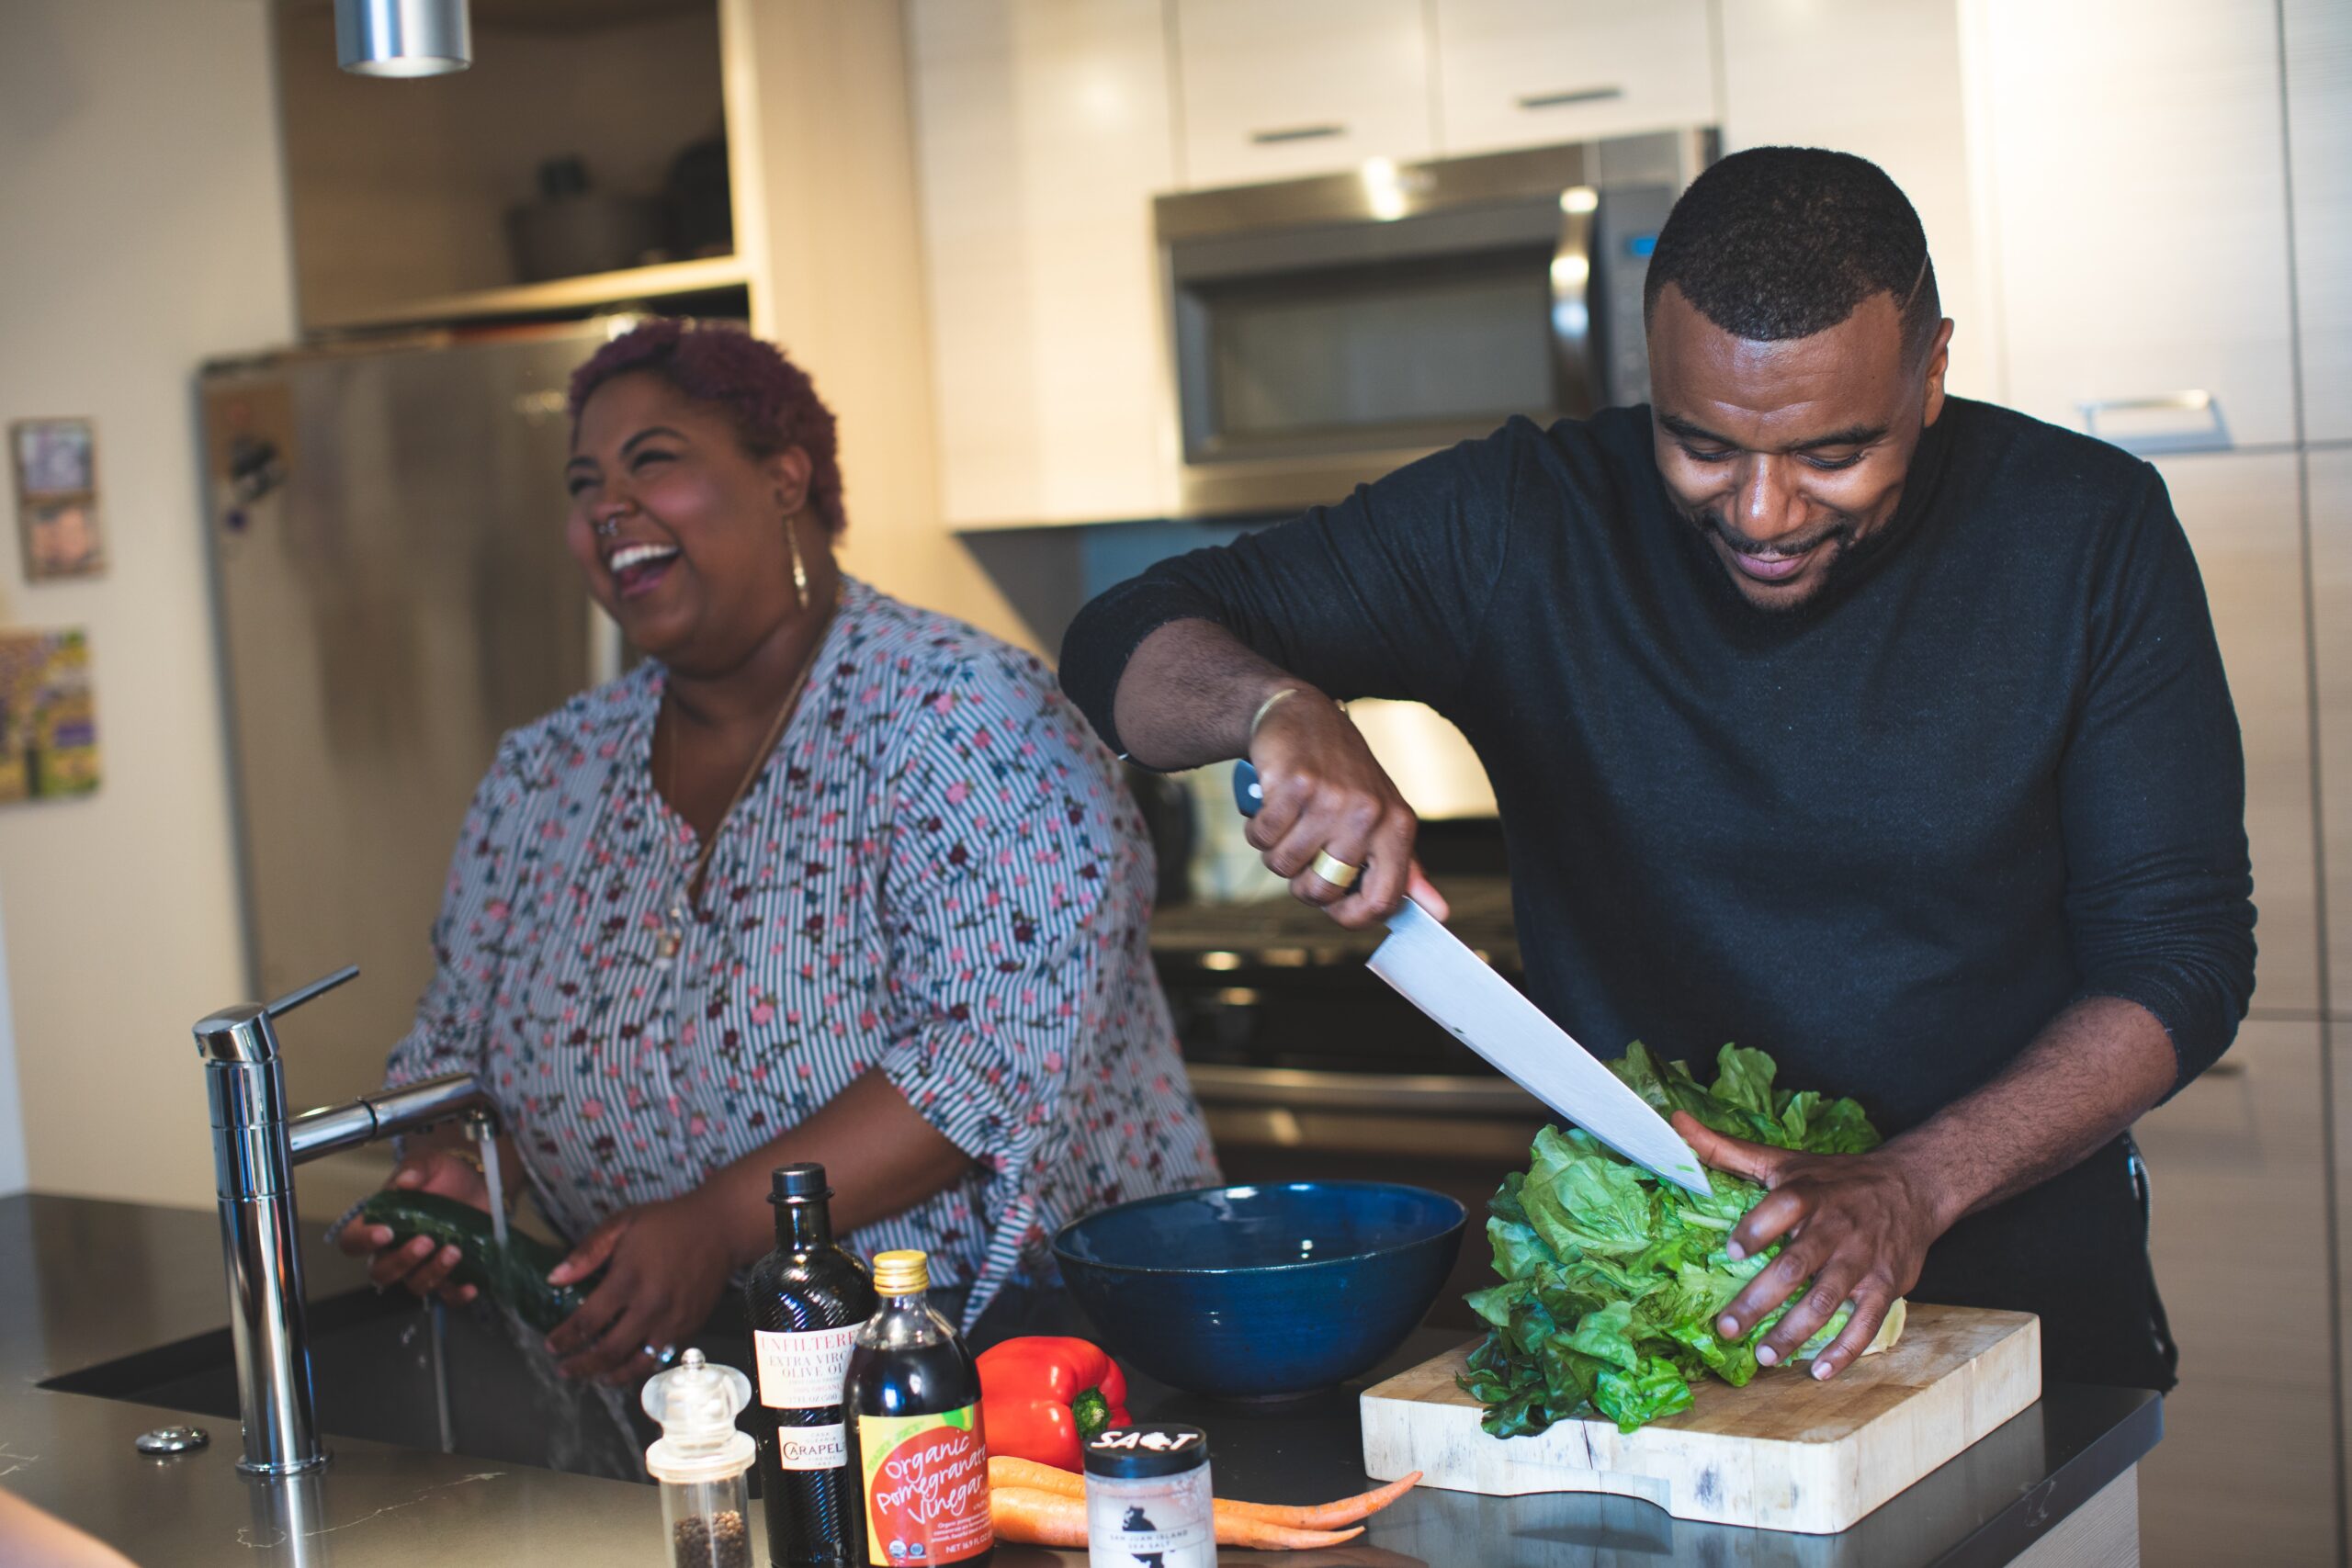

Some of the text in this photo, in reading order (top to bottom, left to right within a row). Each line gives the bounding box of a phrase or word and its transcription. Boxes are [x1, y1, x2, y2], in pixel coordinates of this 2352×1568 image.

[761, 1329, 862, 1352] UNFILTERE
[769, 1355, 811, 1368] EXTRA
[782, 1362, 843, 1378] OLIVE OI
[783, 1441, 843, 1461] CARAPEL
[885, 1429, 969, 1484] Organic
[876, 1444, 987, 1516] Pomegranate
[908, 1474, 983, 1525] Vinegar
[1156, 1529, 1189, 1540] ISLAND
[945, 1542, 962, 1554] NET
